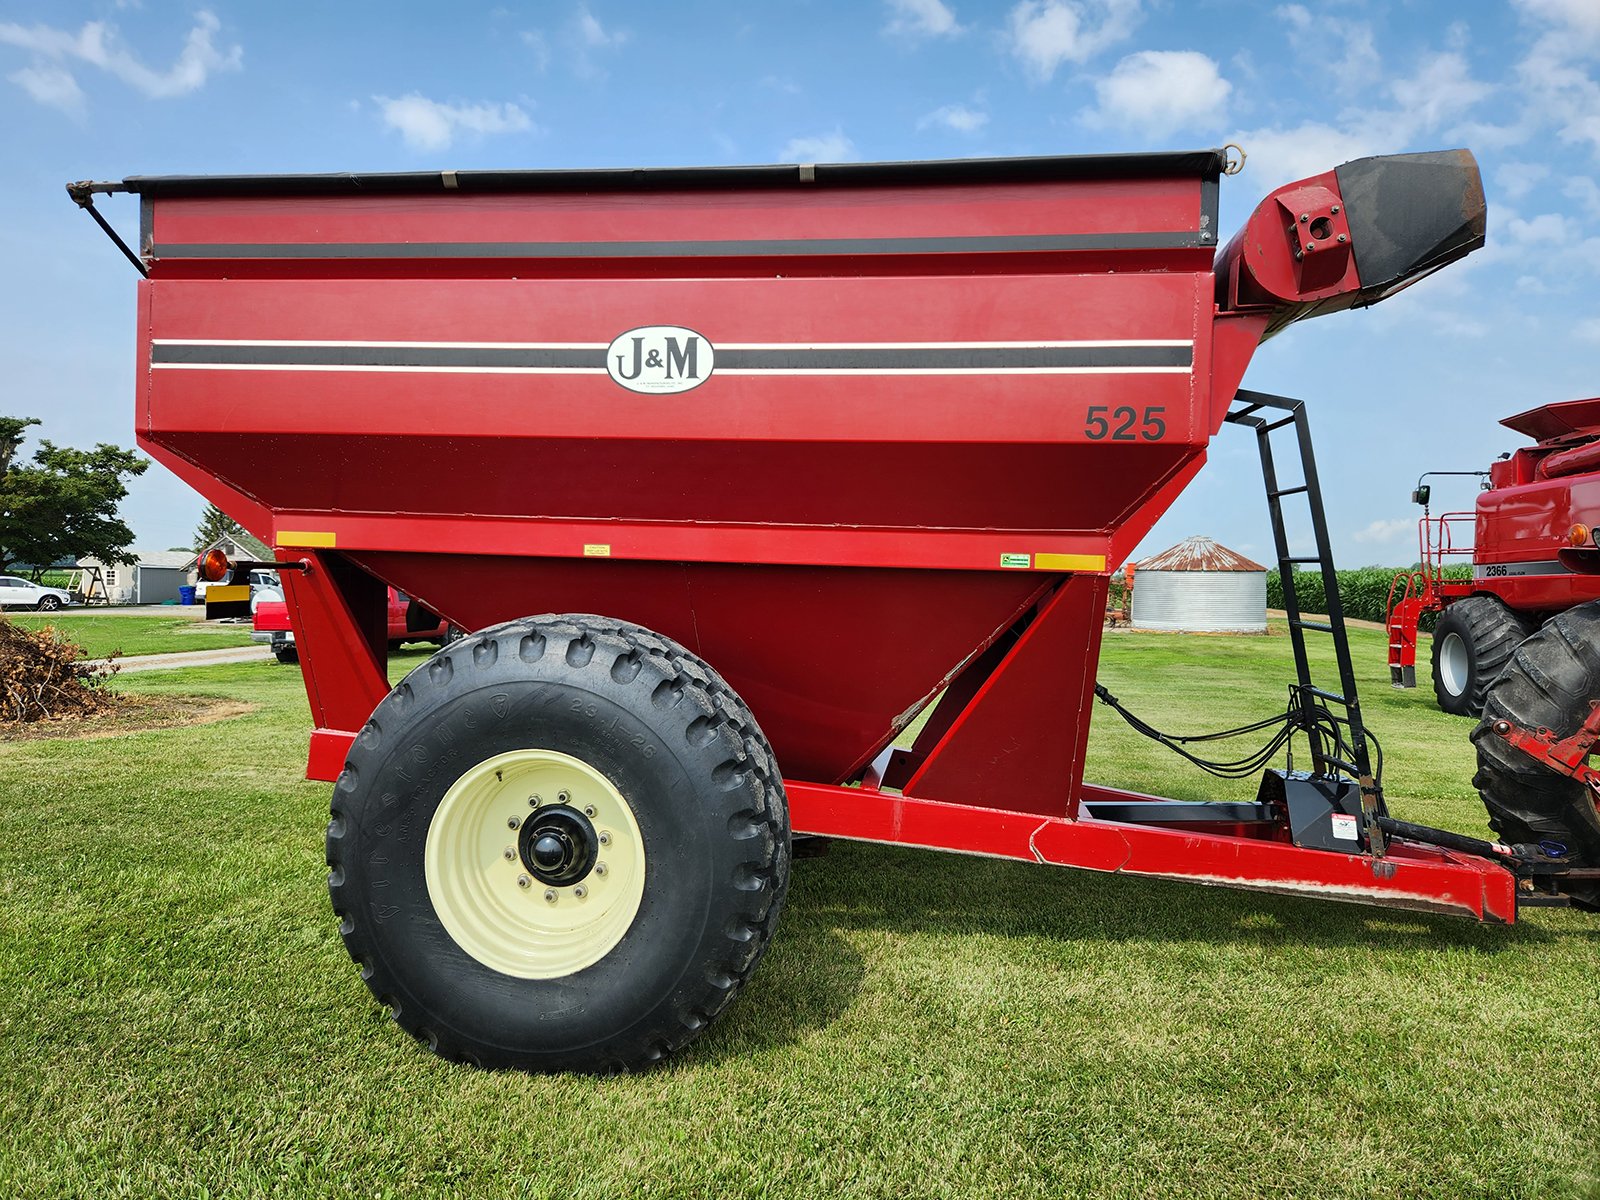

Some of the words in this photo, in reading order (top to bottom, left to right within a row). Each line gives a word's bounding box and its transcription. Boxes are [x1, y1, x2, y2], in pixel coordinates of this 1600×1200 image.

[616, 337, 700, 380] J&M
[1084, 405, 1167, 441] 525
[1486, 564, 1507, 576] 2366
